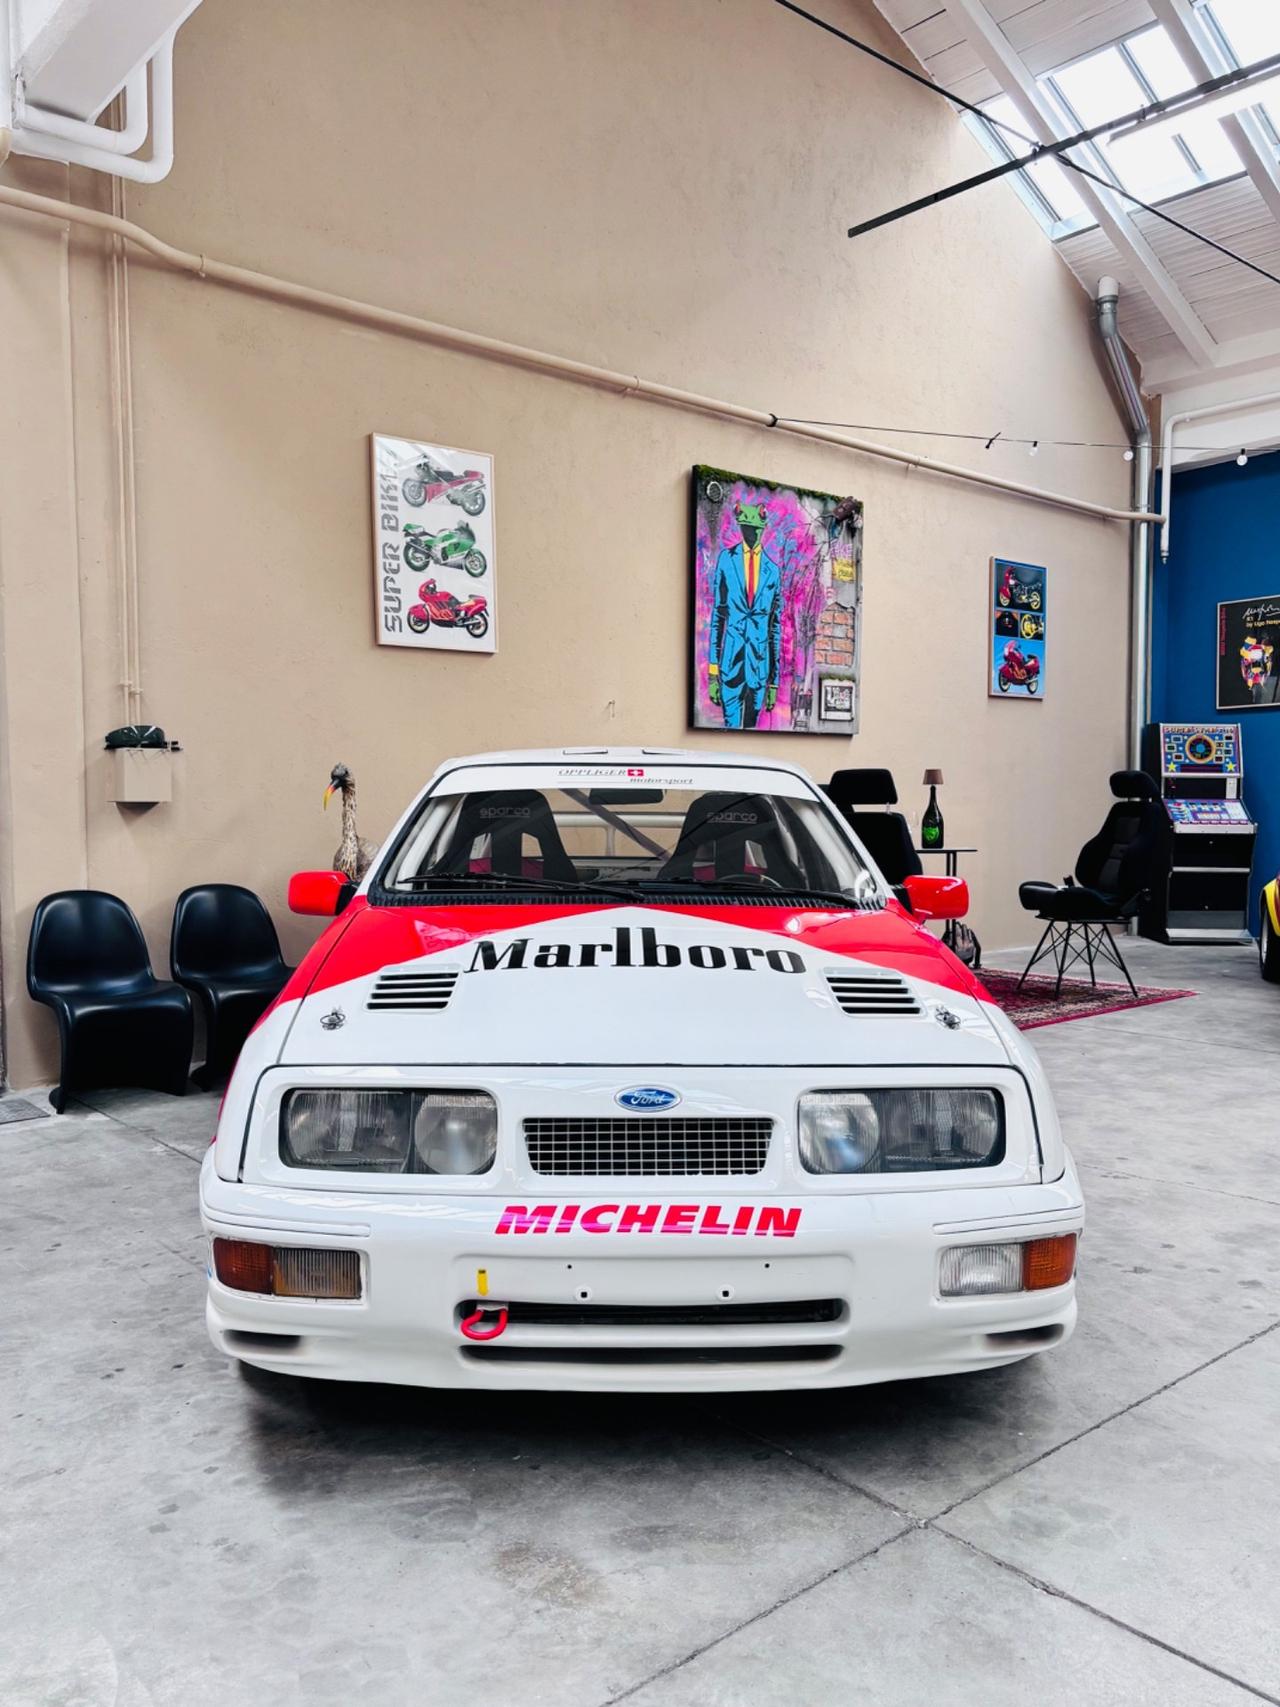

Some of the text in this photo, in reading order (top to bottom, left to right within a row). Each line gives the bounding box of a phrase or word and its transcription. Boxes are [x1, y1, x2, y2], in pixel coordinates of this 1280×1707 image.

[382, 542, 402, 633] SUPER
[480, 808, 530, 818] sparco
[707, 812, 757, 823] sparco
[464, 927, 806, 974] Marlboro
[630, 1090, 668, 1105] Ford
[495, 1204, 802, 1238] MICHELIN
